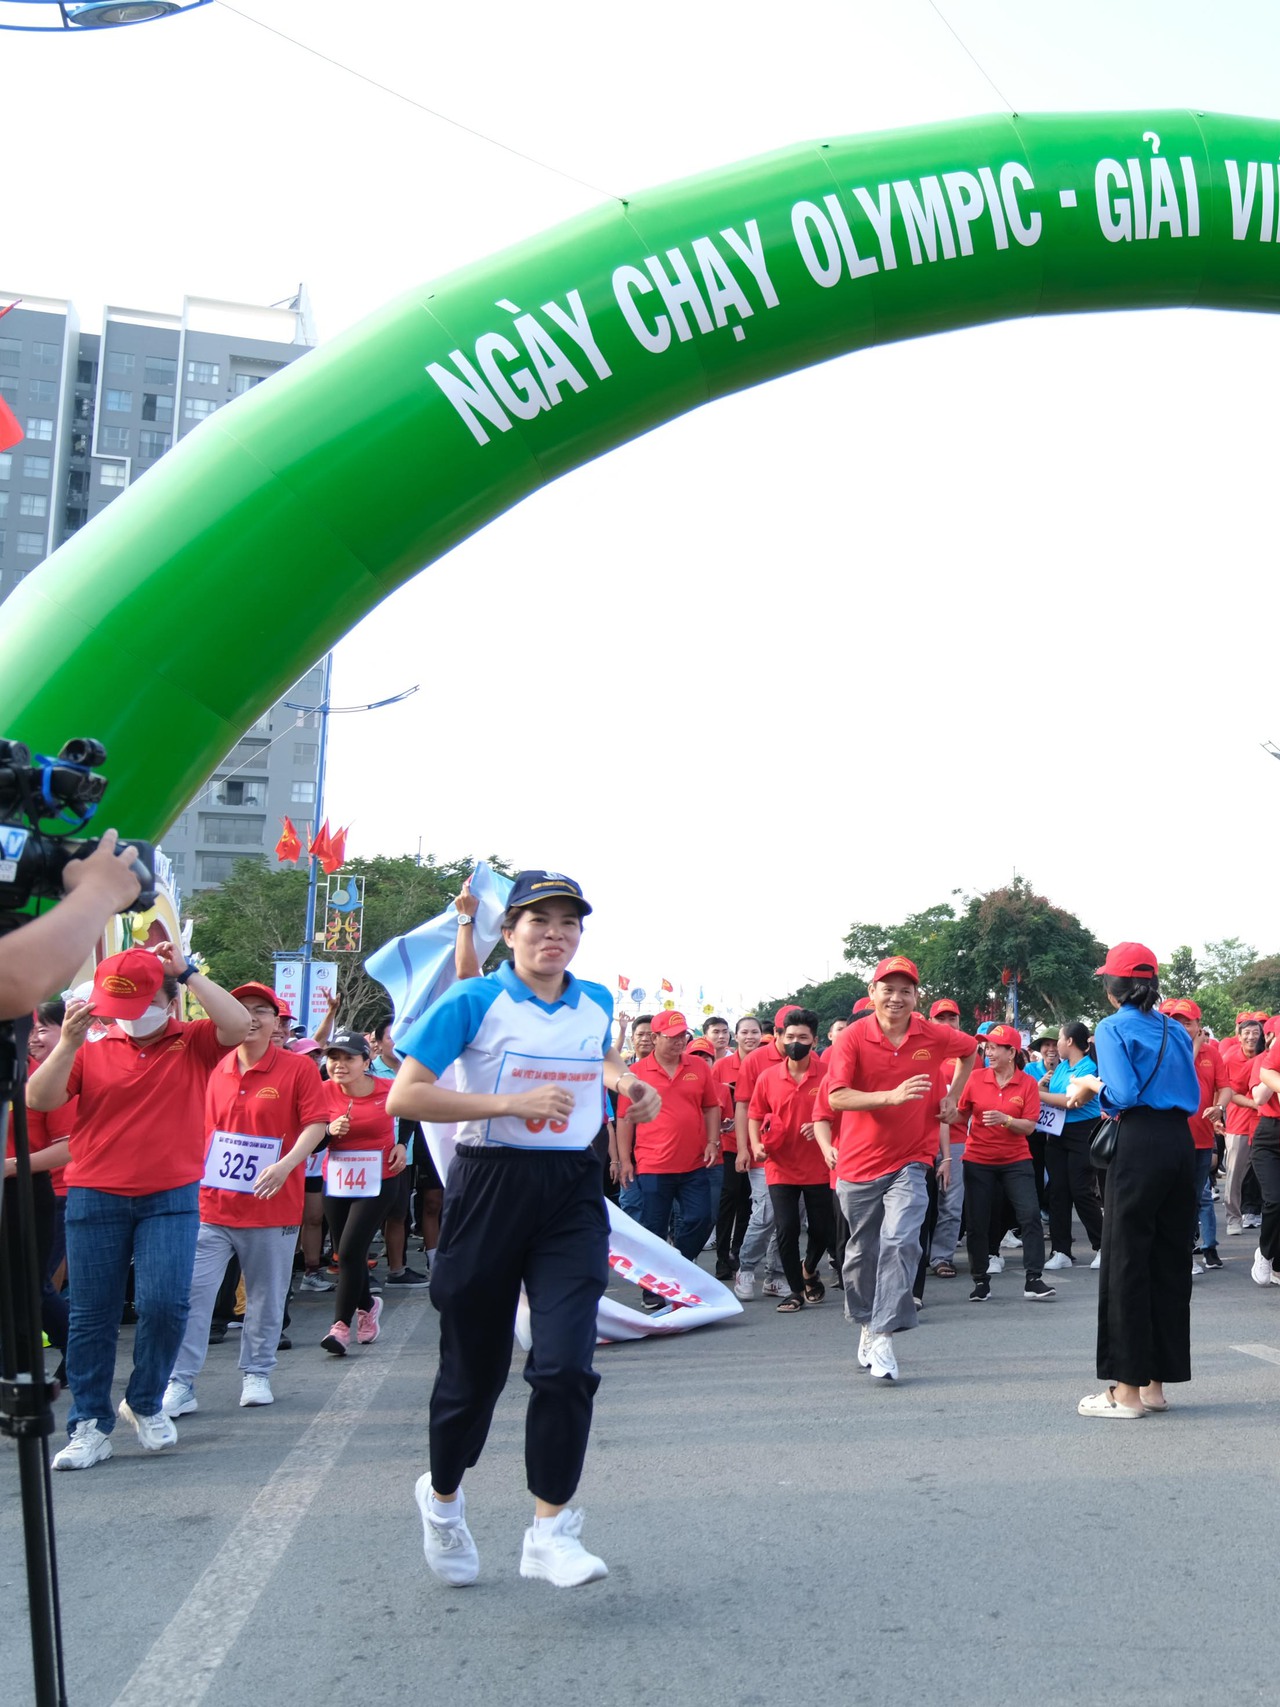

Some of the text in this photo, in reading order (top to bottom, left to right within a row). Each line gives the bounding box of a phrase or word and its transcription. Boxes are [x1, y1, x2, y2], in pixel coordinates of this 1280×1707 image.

[425, 290, 612, 446] NGÀY
[612, 219, 780, 342] CHẠY
[791, 162, 1042, 288] OLYMPIC
[1095, 131, 1200, 243] GIẢI
[1038, 1109, 1056, 1127] 252
[219, 1151, 259, 1182] 325
[336, 1168, 366, 1190] 144
